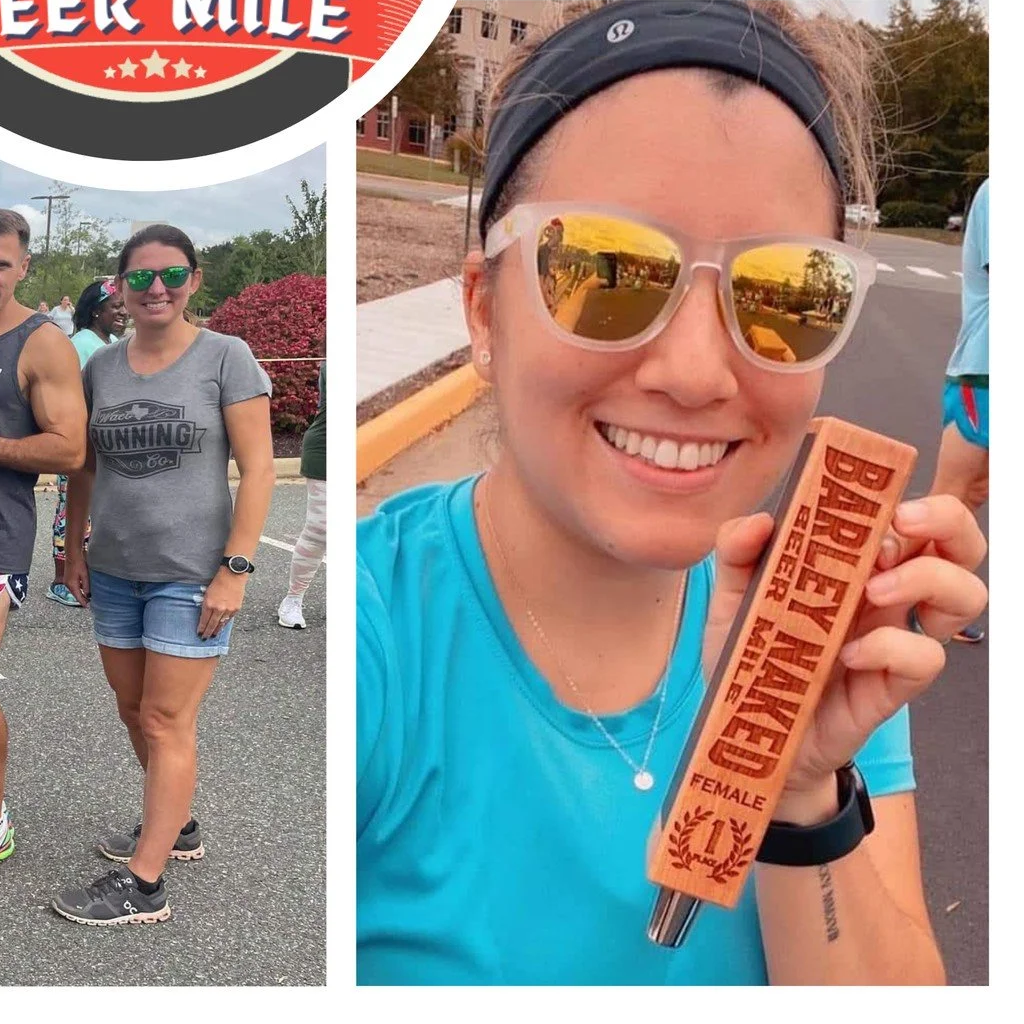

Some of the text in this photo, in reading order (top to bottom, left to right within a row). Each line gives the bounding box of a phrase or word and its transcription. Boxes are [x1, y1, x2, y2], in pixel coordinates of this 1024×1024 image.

[91, 423, 191, 451] RUNNING
[708, 445, 896, 780] BARLEY NAKED
[724, 505, 812, 705] BEER MILE
[689, 772, 767, 813] FEMALE
[703, 819, 726, 856] 1
